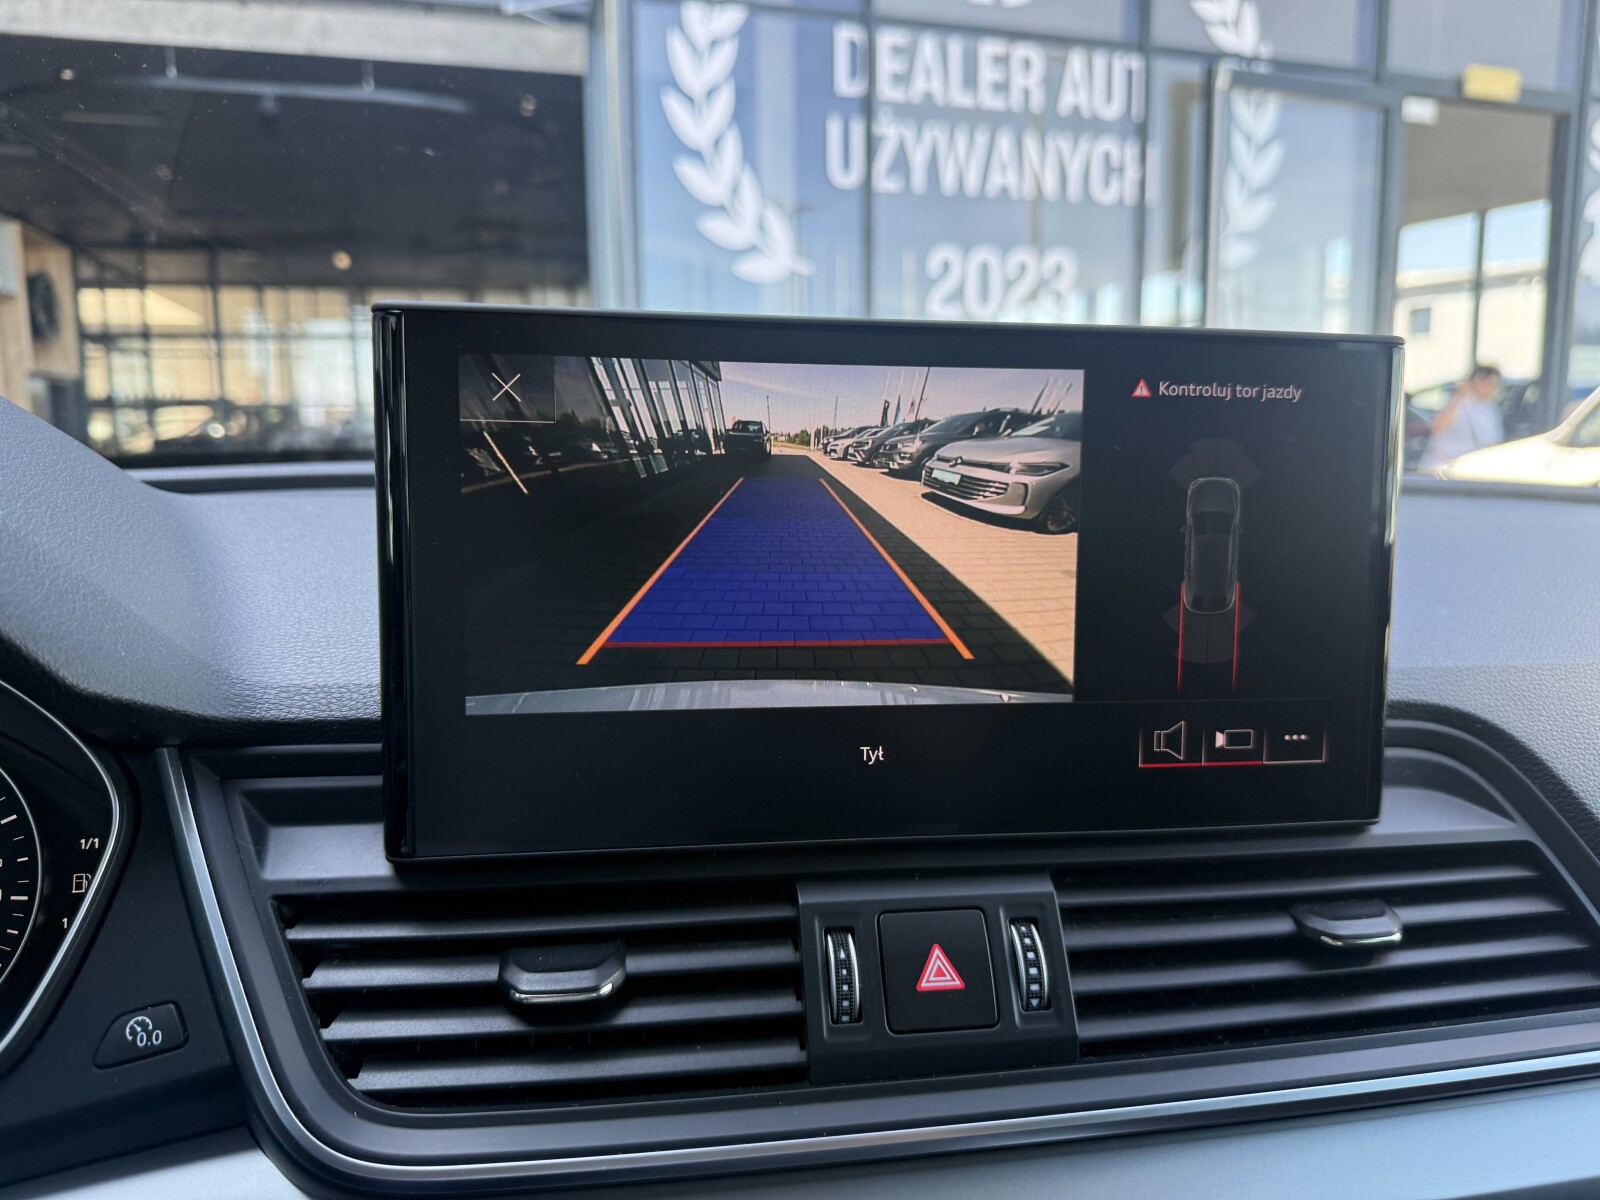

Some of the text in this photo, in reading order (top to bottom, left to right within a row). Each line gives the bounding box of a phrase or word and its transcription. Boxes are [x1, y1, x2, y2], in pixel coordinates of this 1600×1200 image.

[831, 20, 1047, 115] DEALER
[824, 108, 1161, 207] UŻYWANYCH
[924, 242, 1077, 319] 2023
[1158, 381, 1303, 403] Kontroluj tor jazdy
[859, 745, 884, 765] Tył
[80, 837, 100, 850] 1/1
[136, 1029, 163, 1047] 0.0
